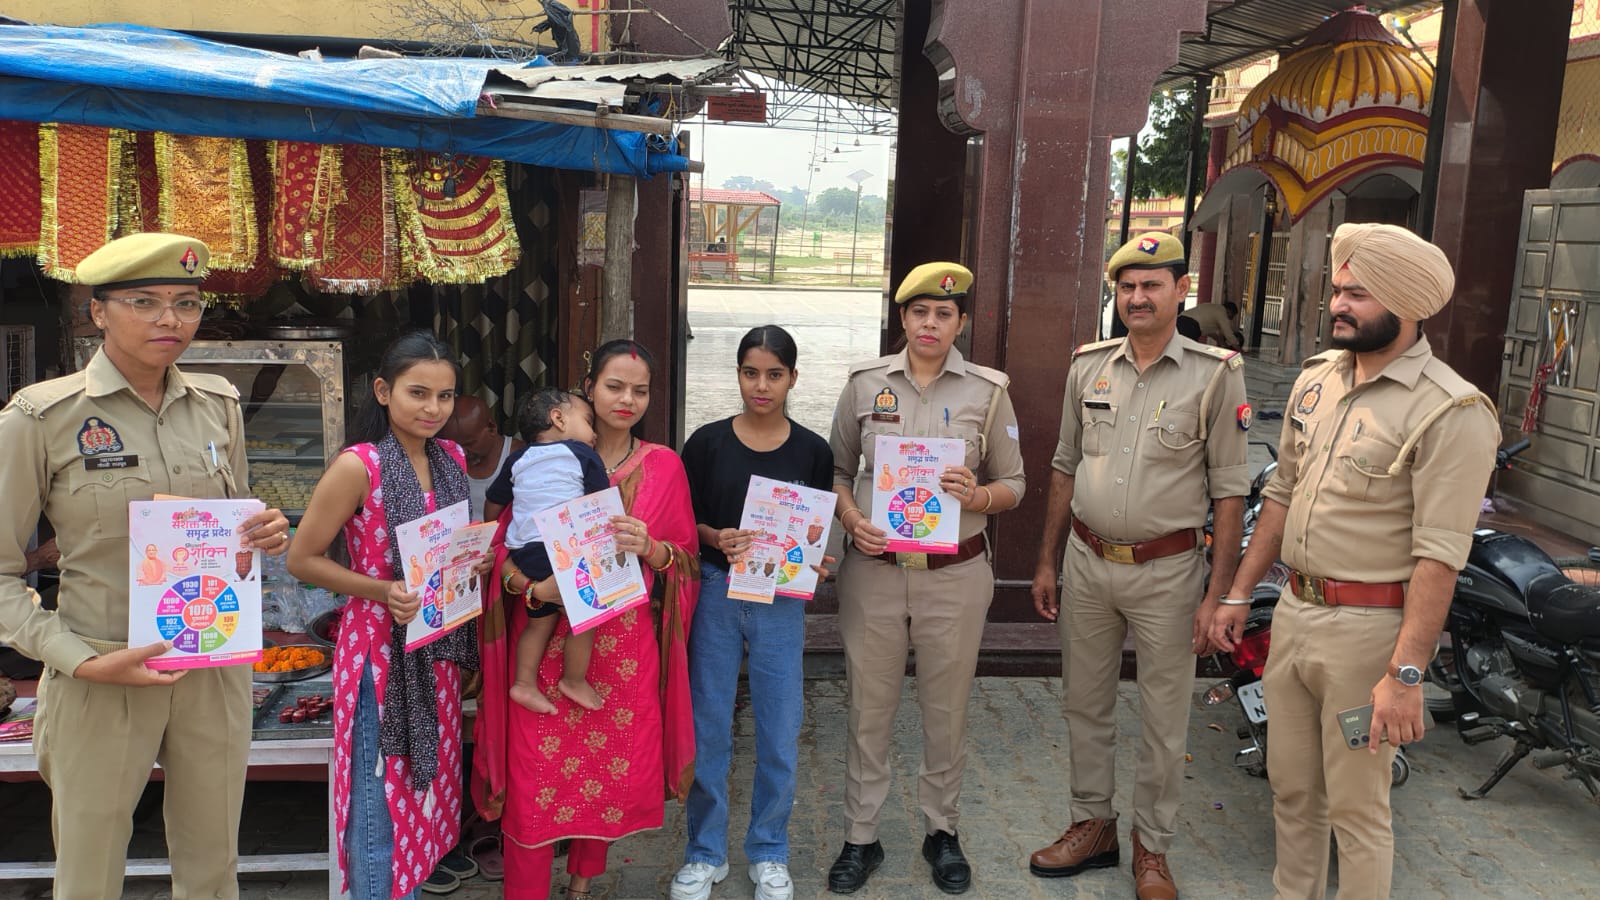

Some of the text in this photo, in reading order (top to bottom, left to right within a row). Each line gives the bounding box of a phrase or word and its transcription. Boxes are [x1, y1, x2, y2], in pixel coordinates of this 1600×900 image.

[172, 517, 219, 529] सशक्त नारी
[186, 526, 232, 540] समृद्ध प्रदेश
[190, 542, 227, 566] शक्ति
[188, 604, 213, 616] 1076
[1254, 704, 1266, 718] N
